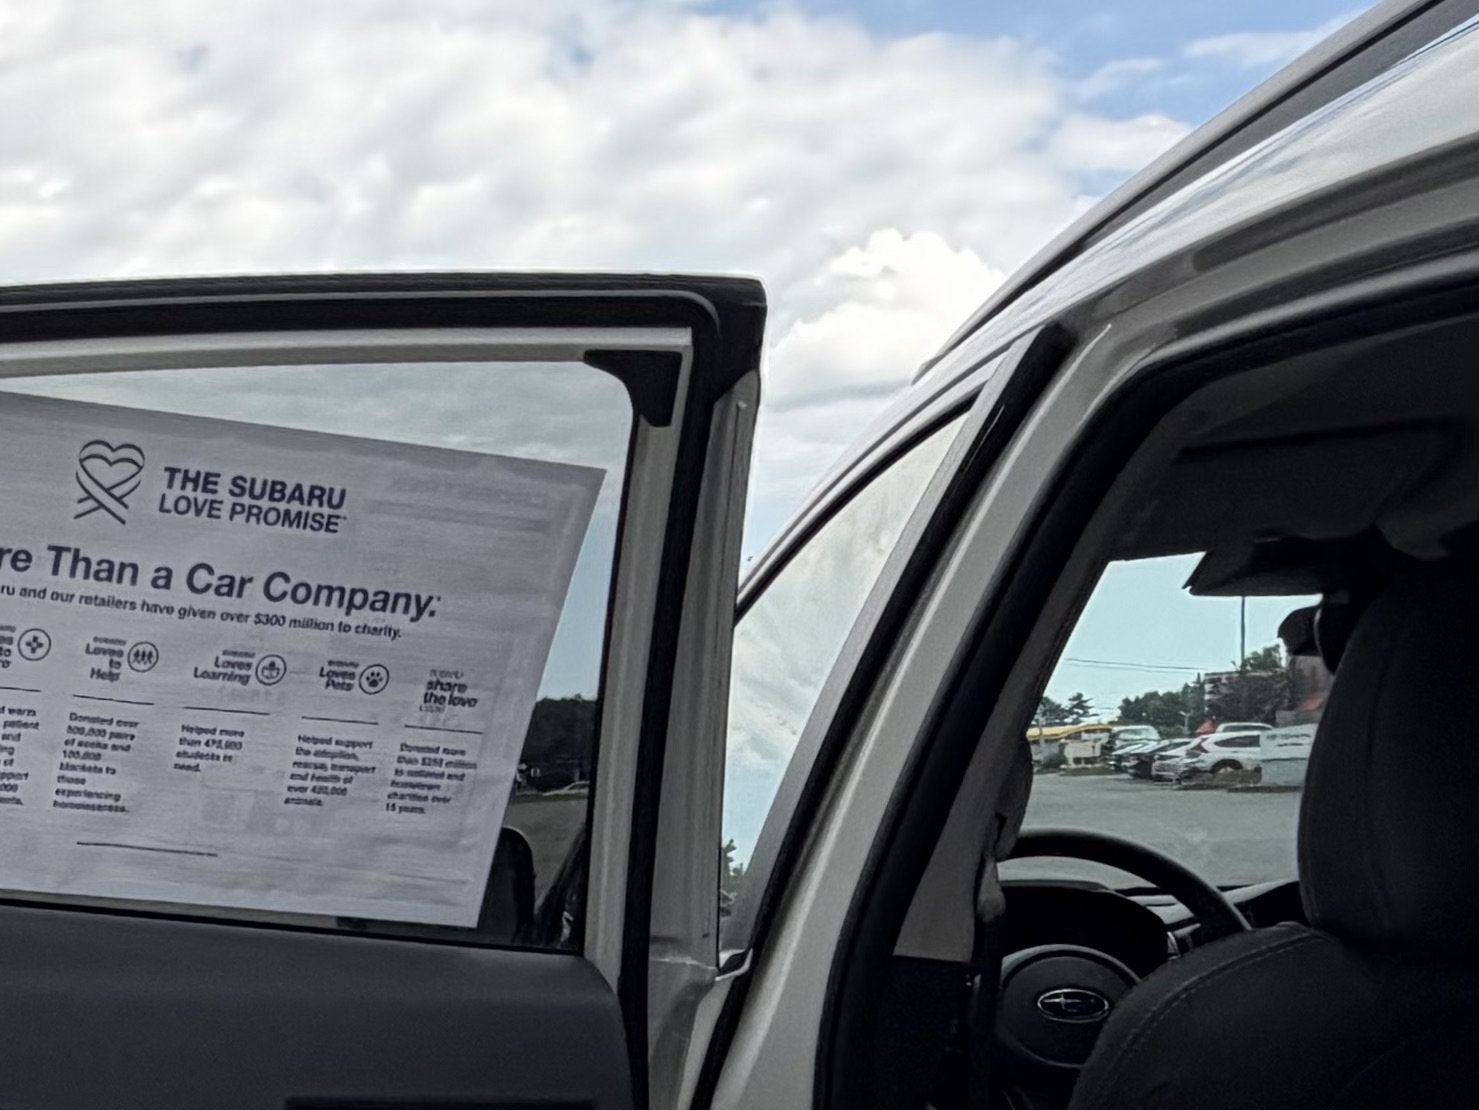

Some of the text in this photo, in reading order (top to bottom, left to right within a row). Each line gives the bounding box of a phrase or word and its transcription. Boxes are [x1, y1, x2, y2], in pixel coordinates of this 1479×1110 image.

[163, 466, 347, 510] THE SUBARU
[158, 493, 223, 519] LOVE
[46, 544, 140, 587] Than
[150, 565, 173, 590] a
[186, 562, 254, 599] Car
[19, 586, 47, 600] and
[50, 590, 76, 604] our
[78, 594, 137, 612] retailers
[140, 600, 175, 616] have
[178, 605, 217, 621] given
[220, 611, 251, 624] over
[254, 612, 286, 628] $300
[289, 617, 335, 633] million
[338, 621, 352, 634] to
[355, 622, 403, 641] charity.
[85, 643, 124, 658] Loves
[109, 657, 122, 670] to
[214, 655, 253, 671] Loves
[90, 667, 121, 683] Help
[193, 666, 251, 686] Learning
[426, 678, 468, 694] share
[423, 691, 479, 708] the love
